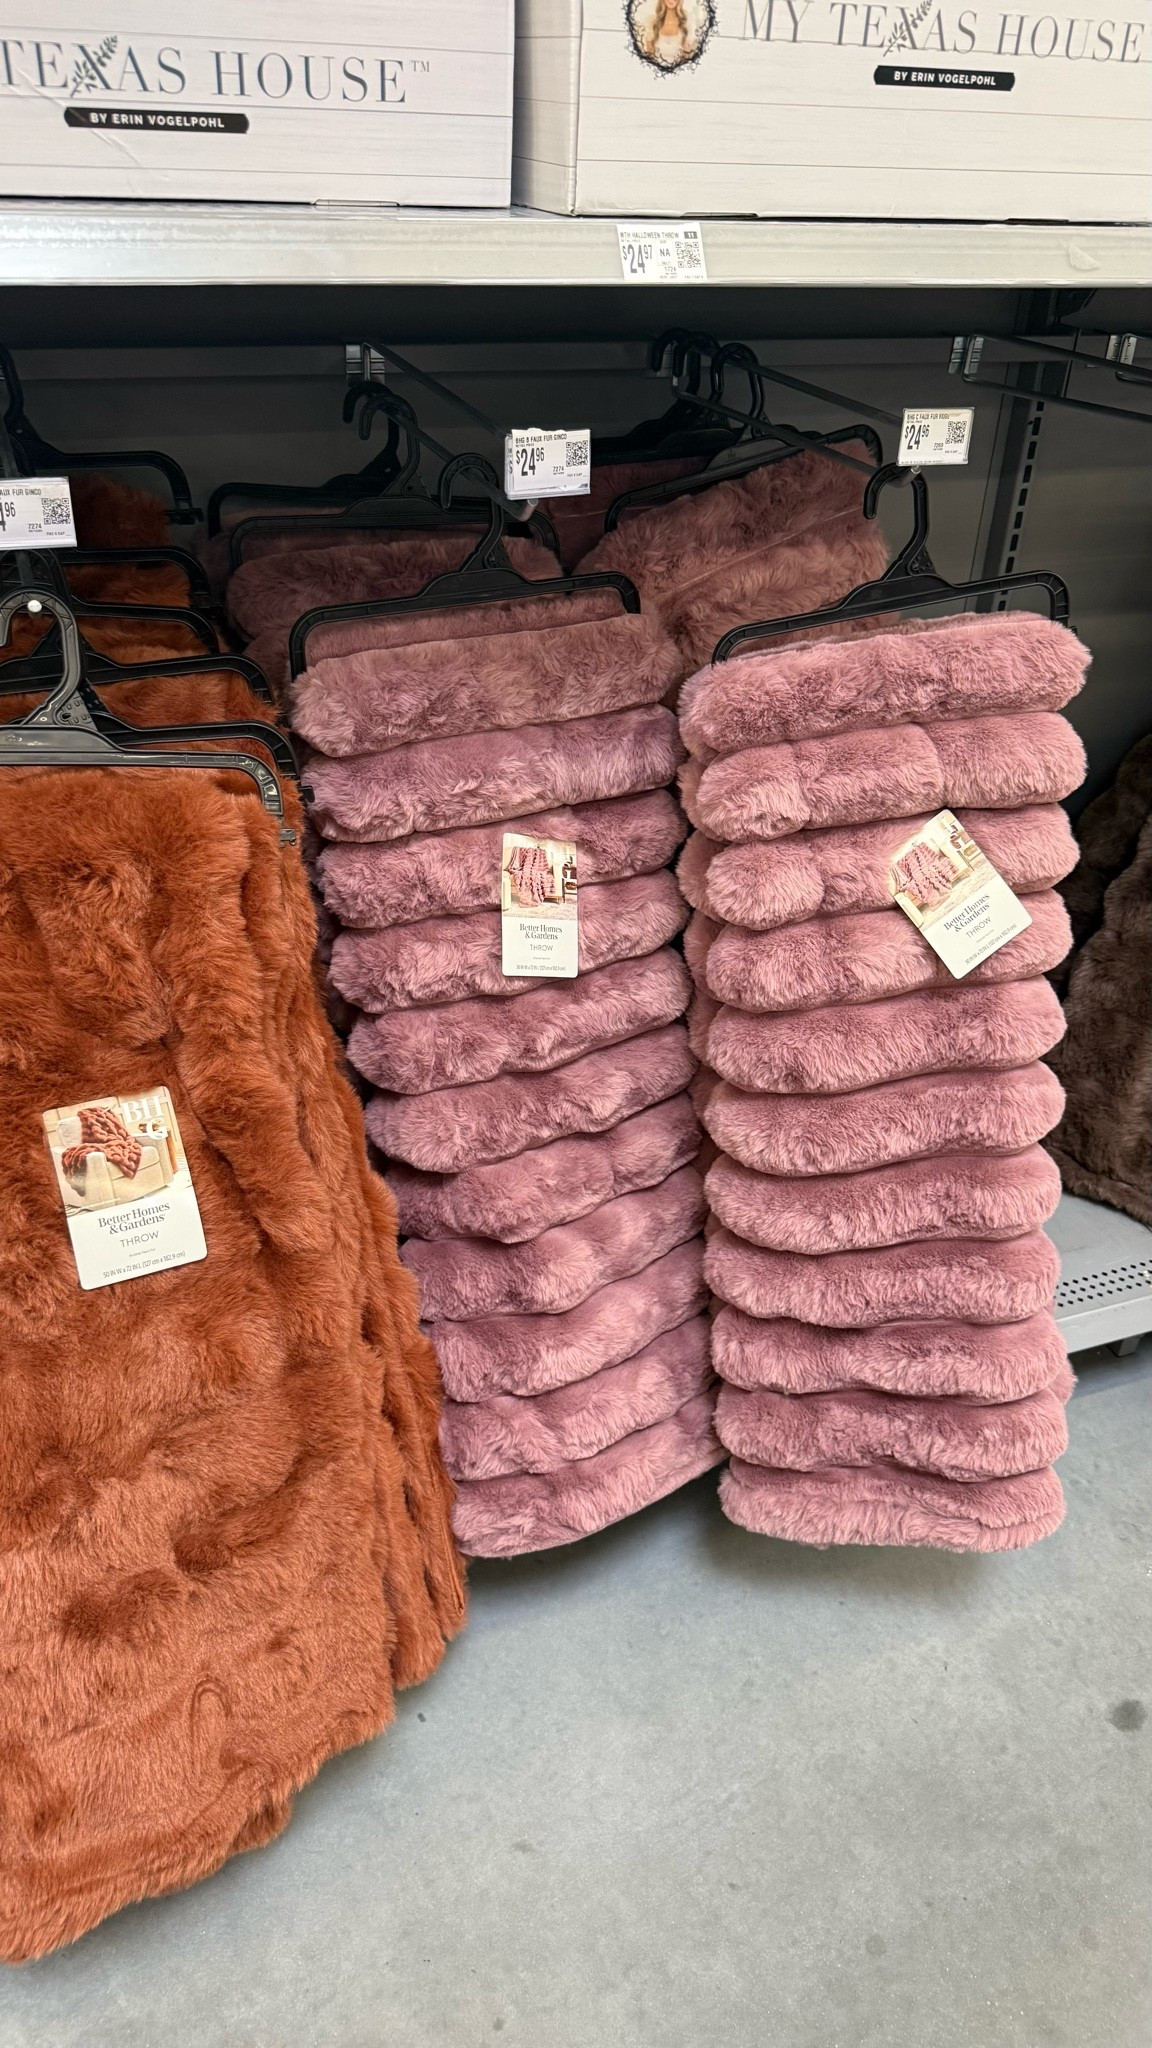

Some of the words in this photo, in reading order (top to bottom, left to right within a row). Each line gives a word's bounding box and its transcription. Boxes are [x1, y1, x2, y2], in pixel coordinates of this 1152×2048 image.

[743, 0, 815, 42] MY
[830, 0, 977, 57] TEXAS
[993, 13, 1145, 63] HOUSE
[0, 36, 186, 97] TEXAS
[894, 70, 908, 81] BY
[911, 72, 934, 83] ERIN
[938, 73, 997, 86] VOGELPOHL
[90, 112, 108, 124] BY
[113, 113, 144, 125] ERIN
[148, 115, 225, 128] VOGELPOHL
[659, 248, 671, 257] NA
[12, 488, 23, 496] FUR
[943, 911, 966, 930] Better
[963, 894, 990, 915] Homes
[519, 923, 539, 932] Better
[540, 924, 562, 933] Homes
[965, 915, 991, 938] THROW
[529, 943, 553, 951] THROW
[98, 1212, 131, 1228] Better
[131, 1203, 170, 1219] Homes
[119, 1214, 165, 1232] Gardens
[120, 1231, 159, 1248] THROW
